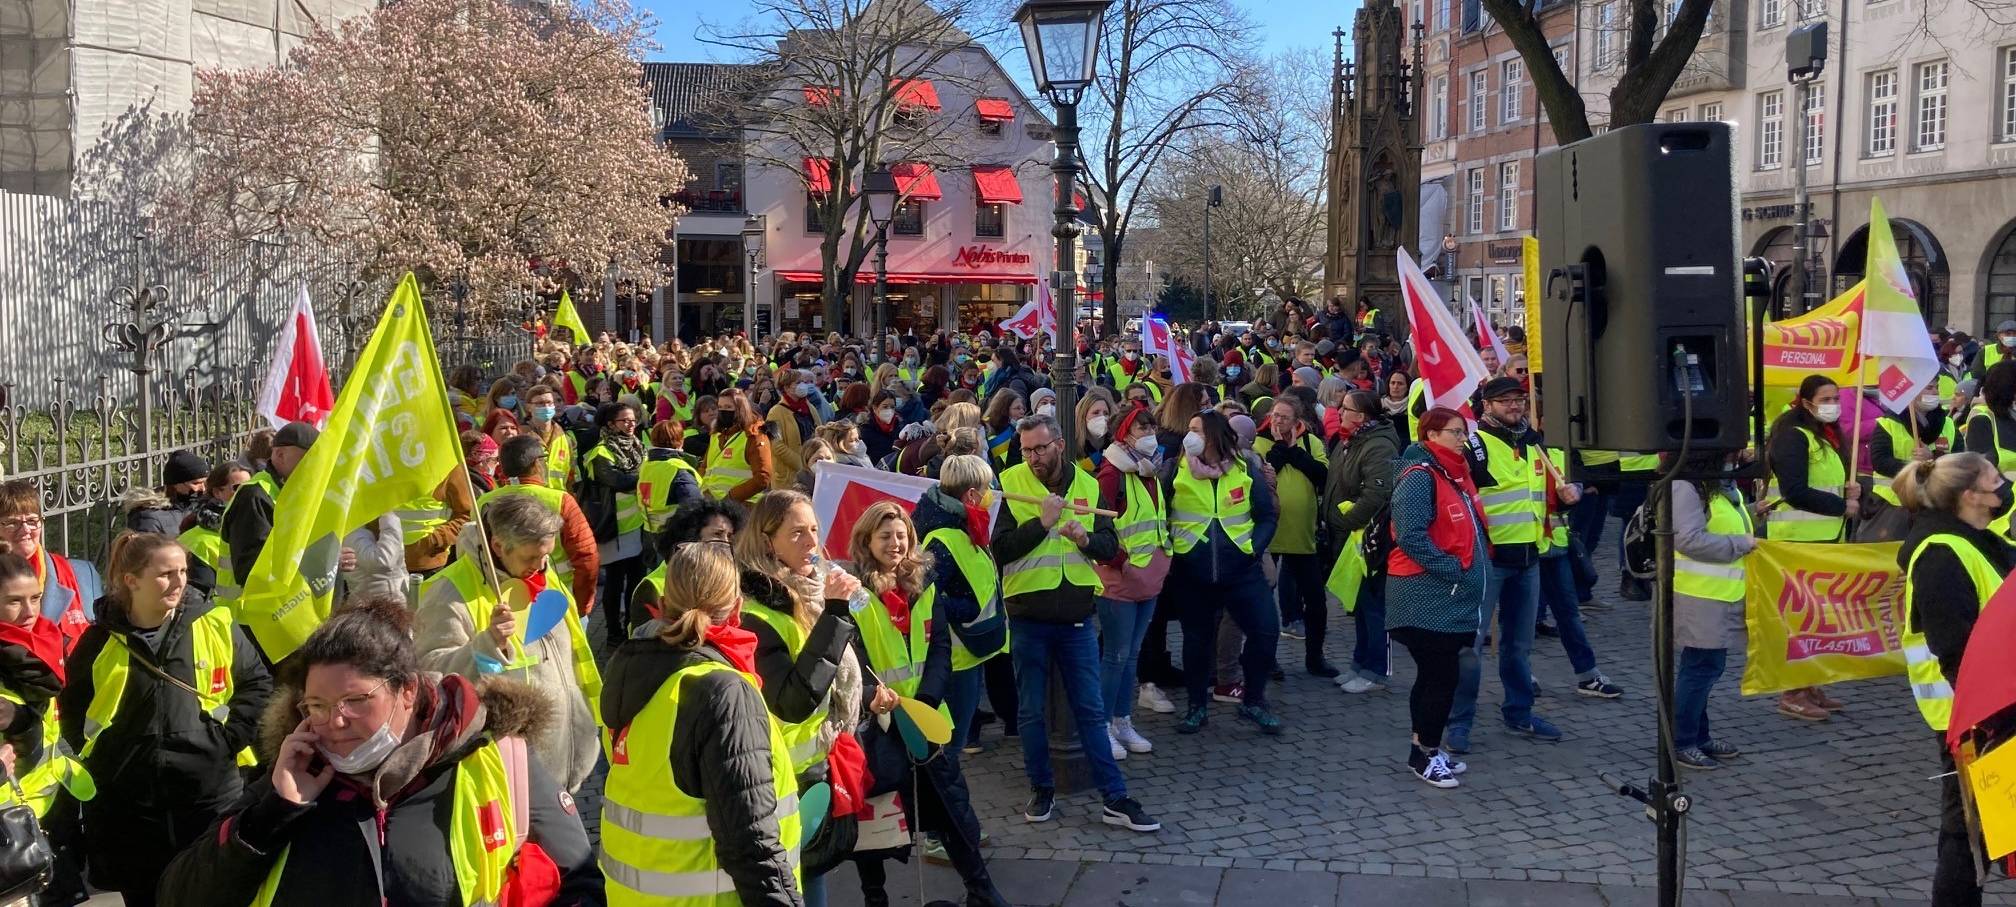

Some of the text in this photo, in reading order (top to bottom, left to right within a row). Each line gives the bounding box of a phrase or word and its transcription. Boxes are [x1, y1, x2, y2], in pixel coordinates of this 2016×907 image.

[952, 244, 1030, 270] Nobis Printen
[1780, 350, 1827, 365] PERSONAL
[1778, 569, 1889, 634] MEHR
[1798, 636, 1872, 654] NTLASTUNG
